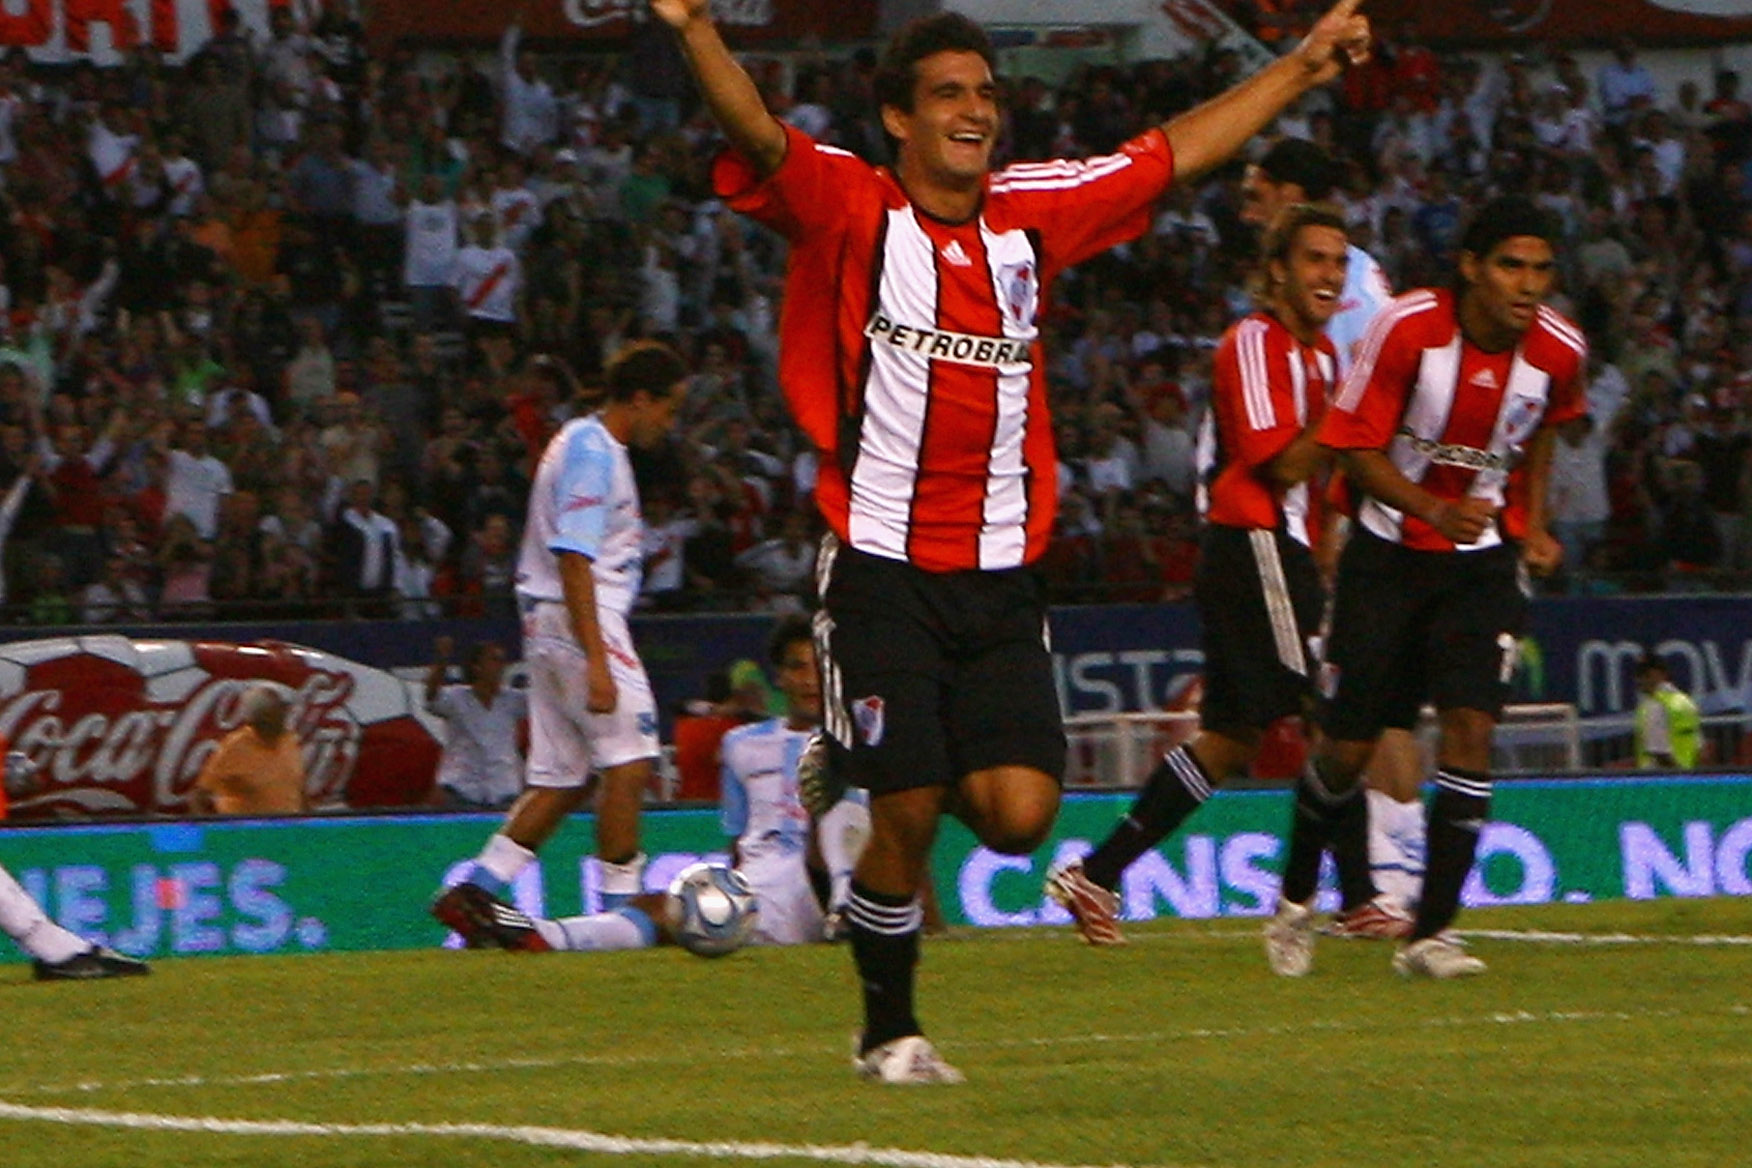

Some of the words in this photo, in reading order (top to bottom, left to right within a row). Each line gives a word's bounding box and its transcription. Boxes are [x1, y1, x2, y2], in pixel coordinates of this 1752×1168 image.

[870, 316, 1030, 363] PETROBR
[14, 856, 330, 956] EJES.
[957, 820, 1592, 928] CNSO.
